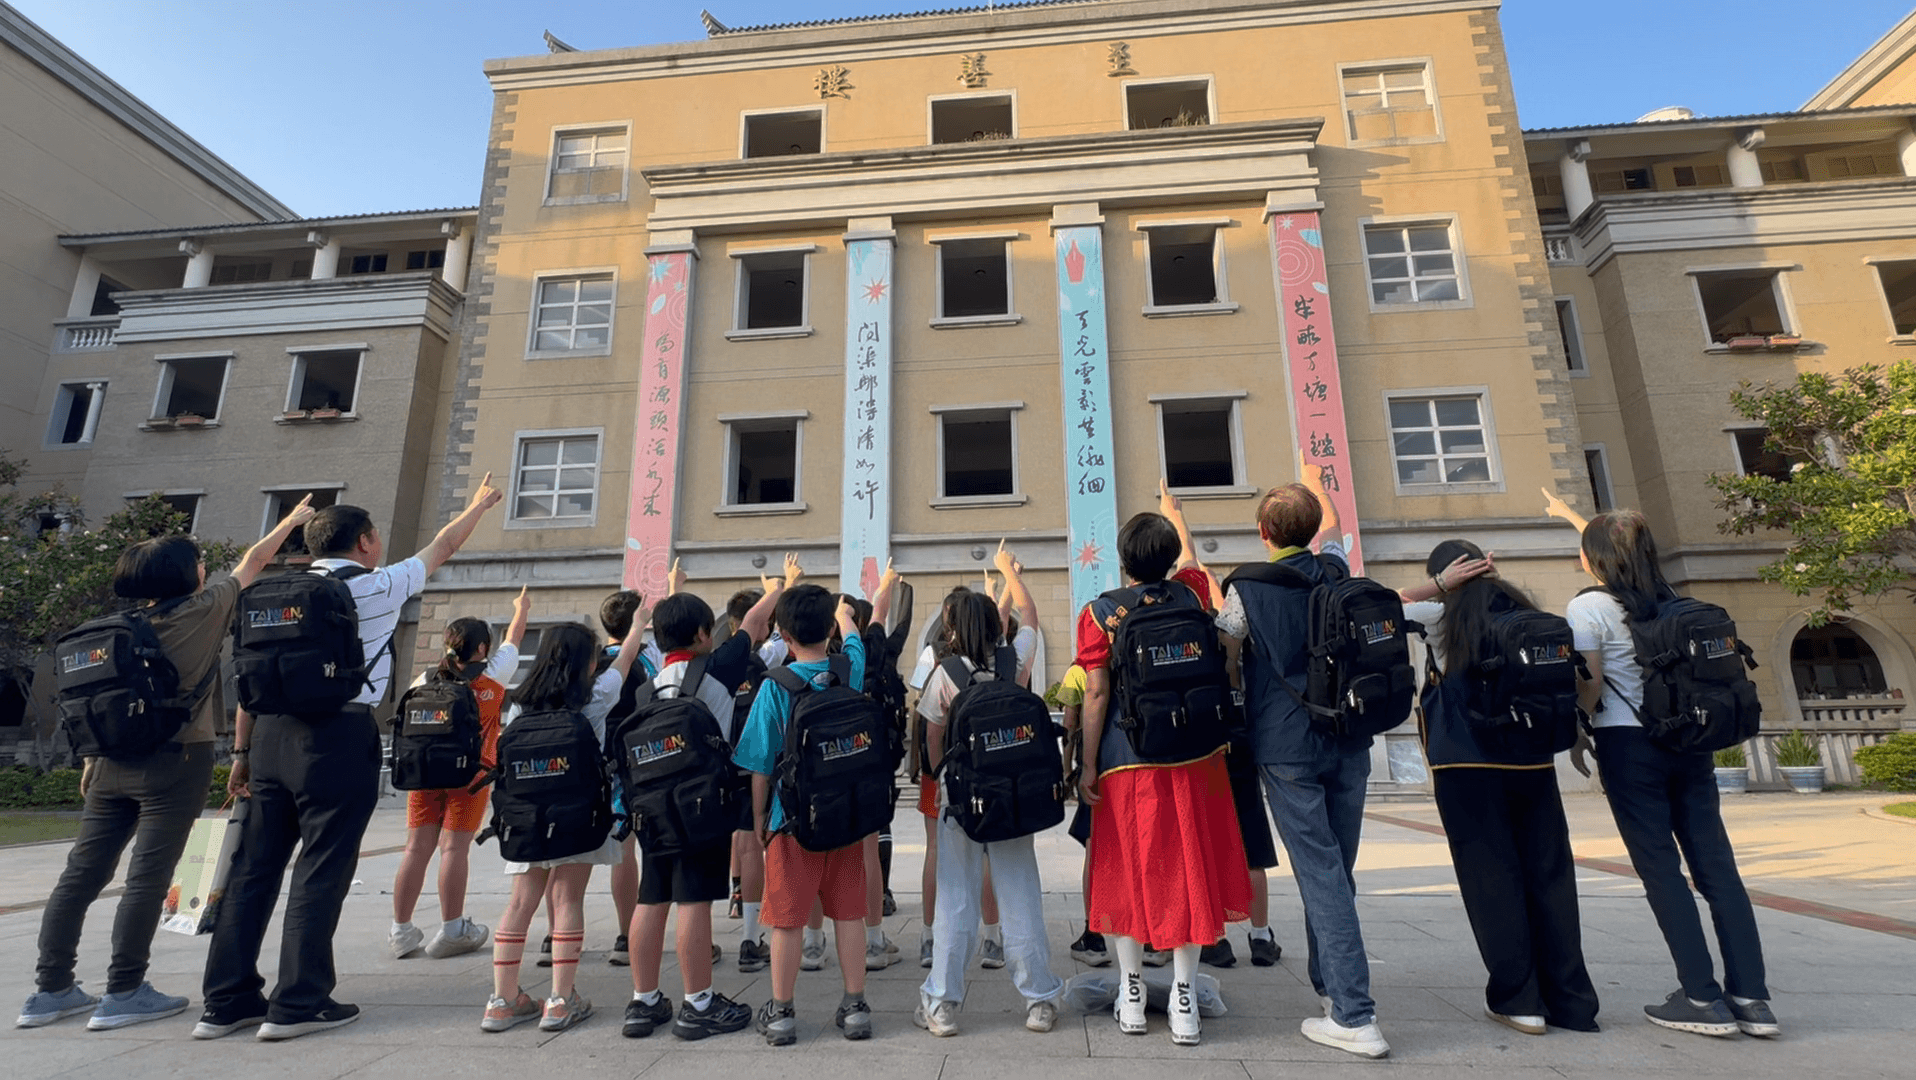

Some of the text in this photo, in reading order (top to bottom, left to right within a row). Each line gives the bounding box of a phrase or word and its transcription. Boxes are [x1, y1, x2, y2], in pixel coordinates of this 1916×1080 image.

[247, 606, 303, 622] TAIWAN
[1361, 620, 1396, 638] TAIWAN
[61, 648, 108, 669] TAIWAN
[1148, 641, 1202, 660] TAIWAN
[410, 709, 448, 722] TAIWAN
[818, 731, 872, 755] TAIWAN
[980, 724, 1035, 746] TAIWAN
[631, 734, 685, 759] TAIWAN
[512, 756, 570, 774] TAIWAN
[1129, 972, 1141, 1003] LOVE
[1178, 981, 1192, 1014] LOVE
